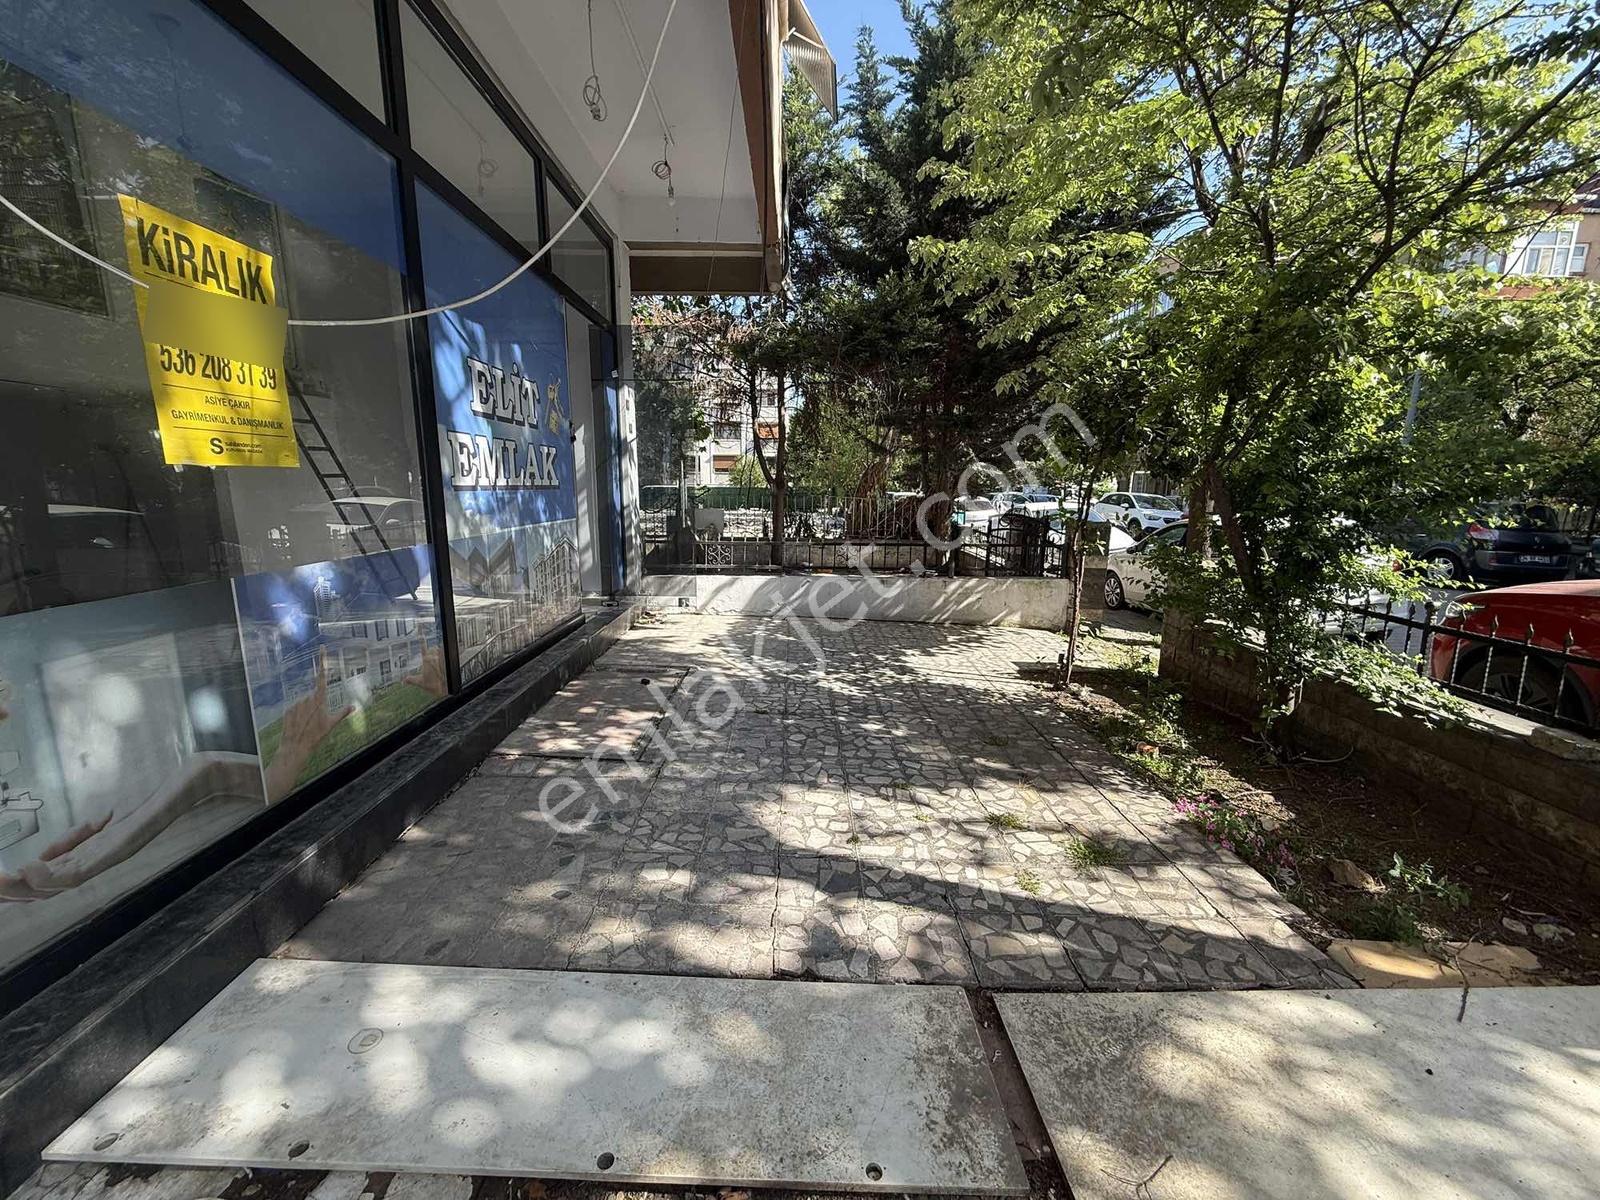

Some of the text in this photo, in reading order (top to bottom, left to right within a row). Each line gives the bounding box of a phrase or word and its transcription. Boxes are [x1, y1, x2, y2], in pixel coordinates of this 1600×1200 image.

[160, 345, 196, 376] 536
[230, 416, 237, 426] &
[447, 429, 560, 491] EMLAK
